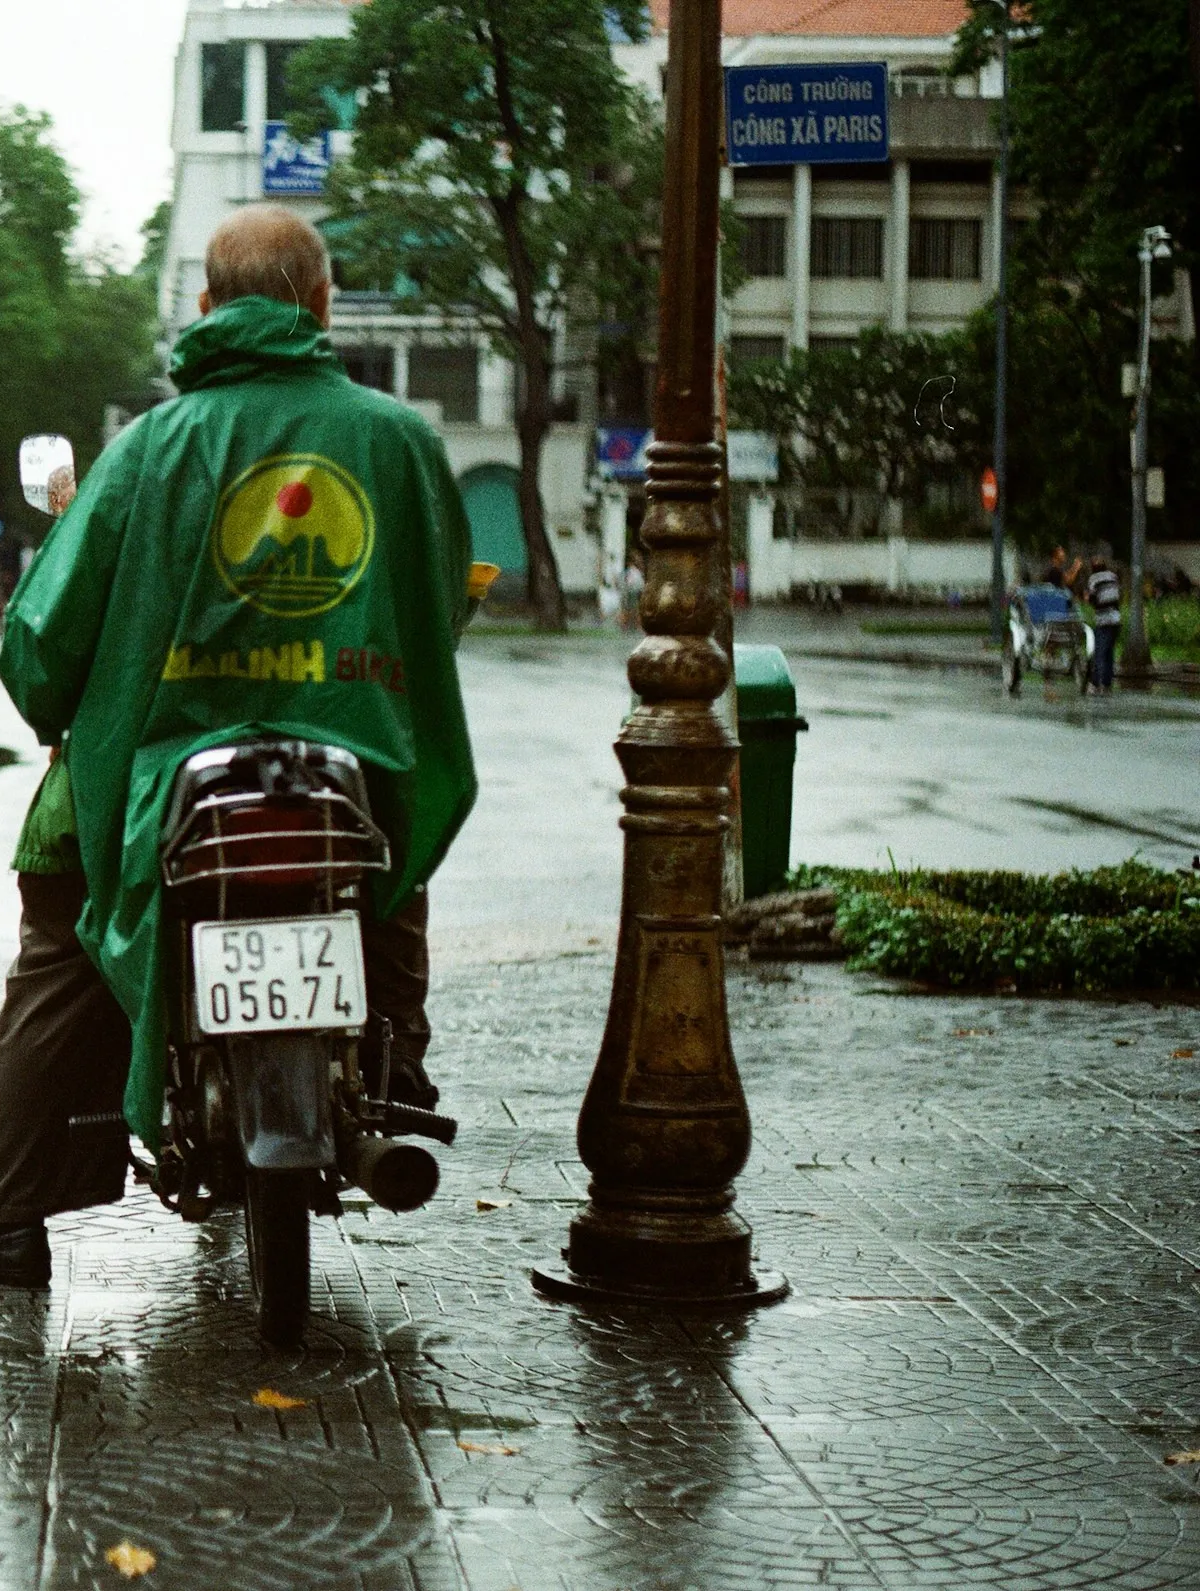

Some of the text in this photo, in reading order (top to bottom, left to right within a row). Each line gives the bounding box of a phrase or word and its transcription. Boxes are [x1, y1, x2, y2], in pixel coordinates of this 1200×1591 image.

[744, 74, 873, 104] CÔNG TRƯỜNG
[732, 109, 883, 147] CÔNG XÃ PARIS
[211, 974, 352, 1025] 056.74
